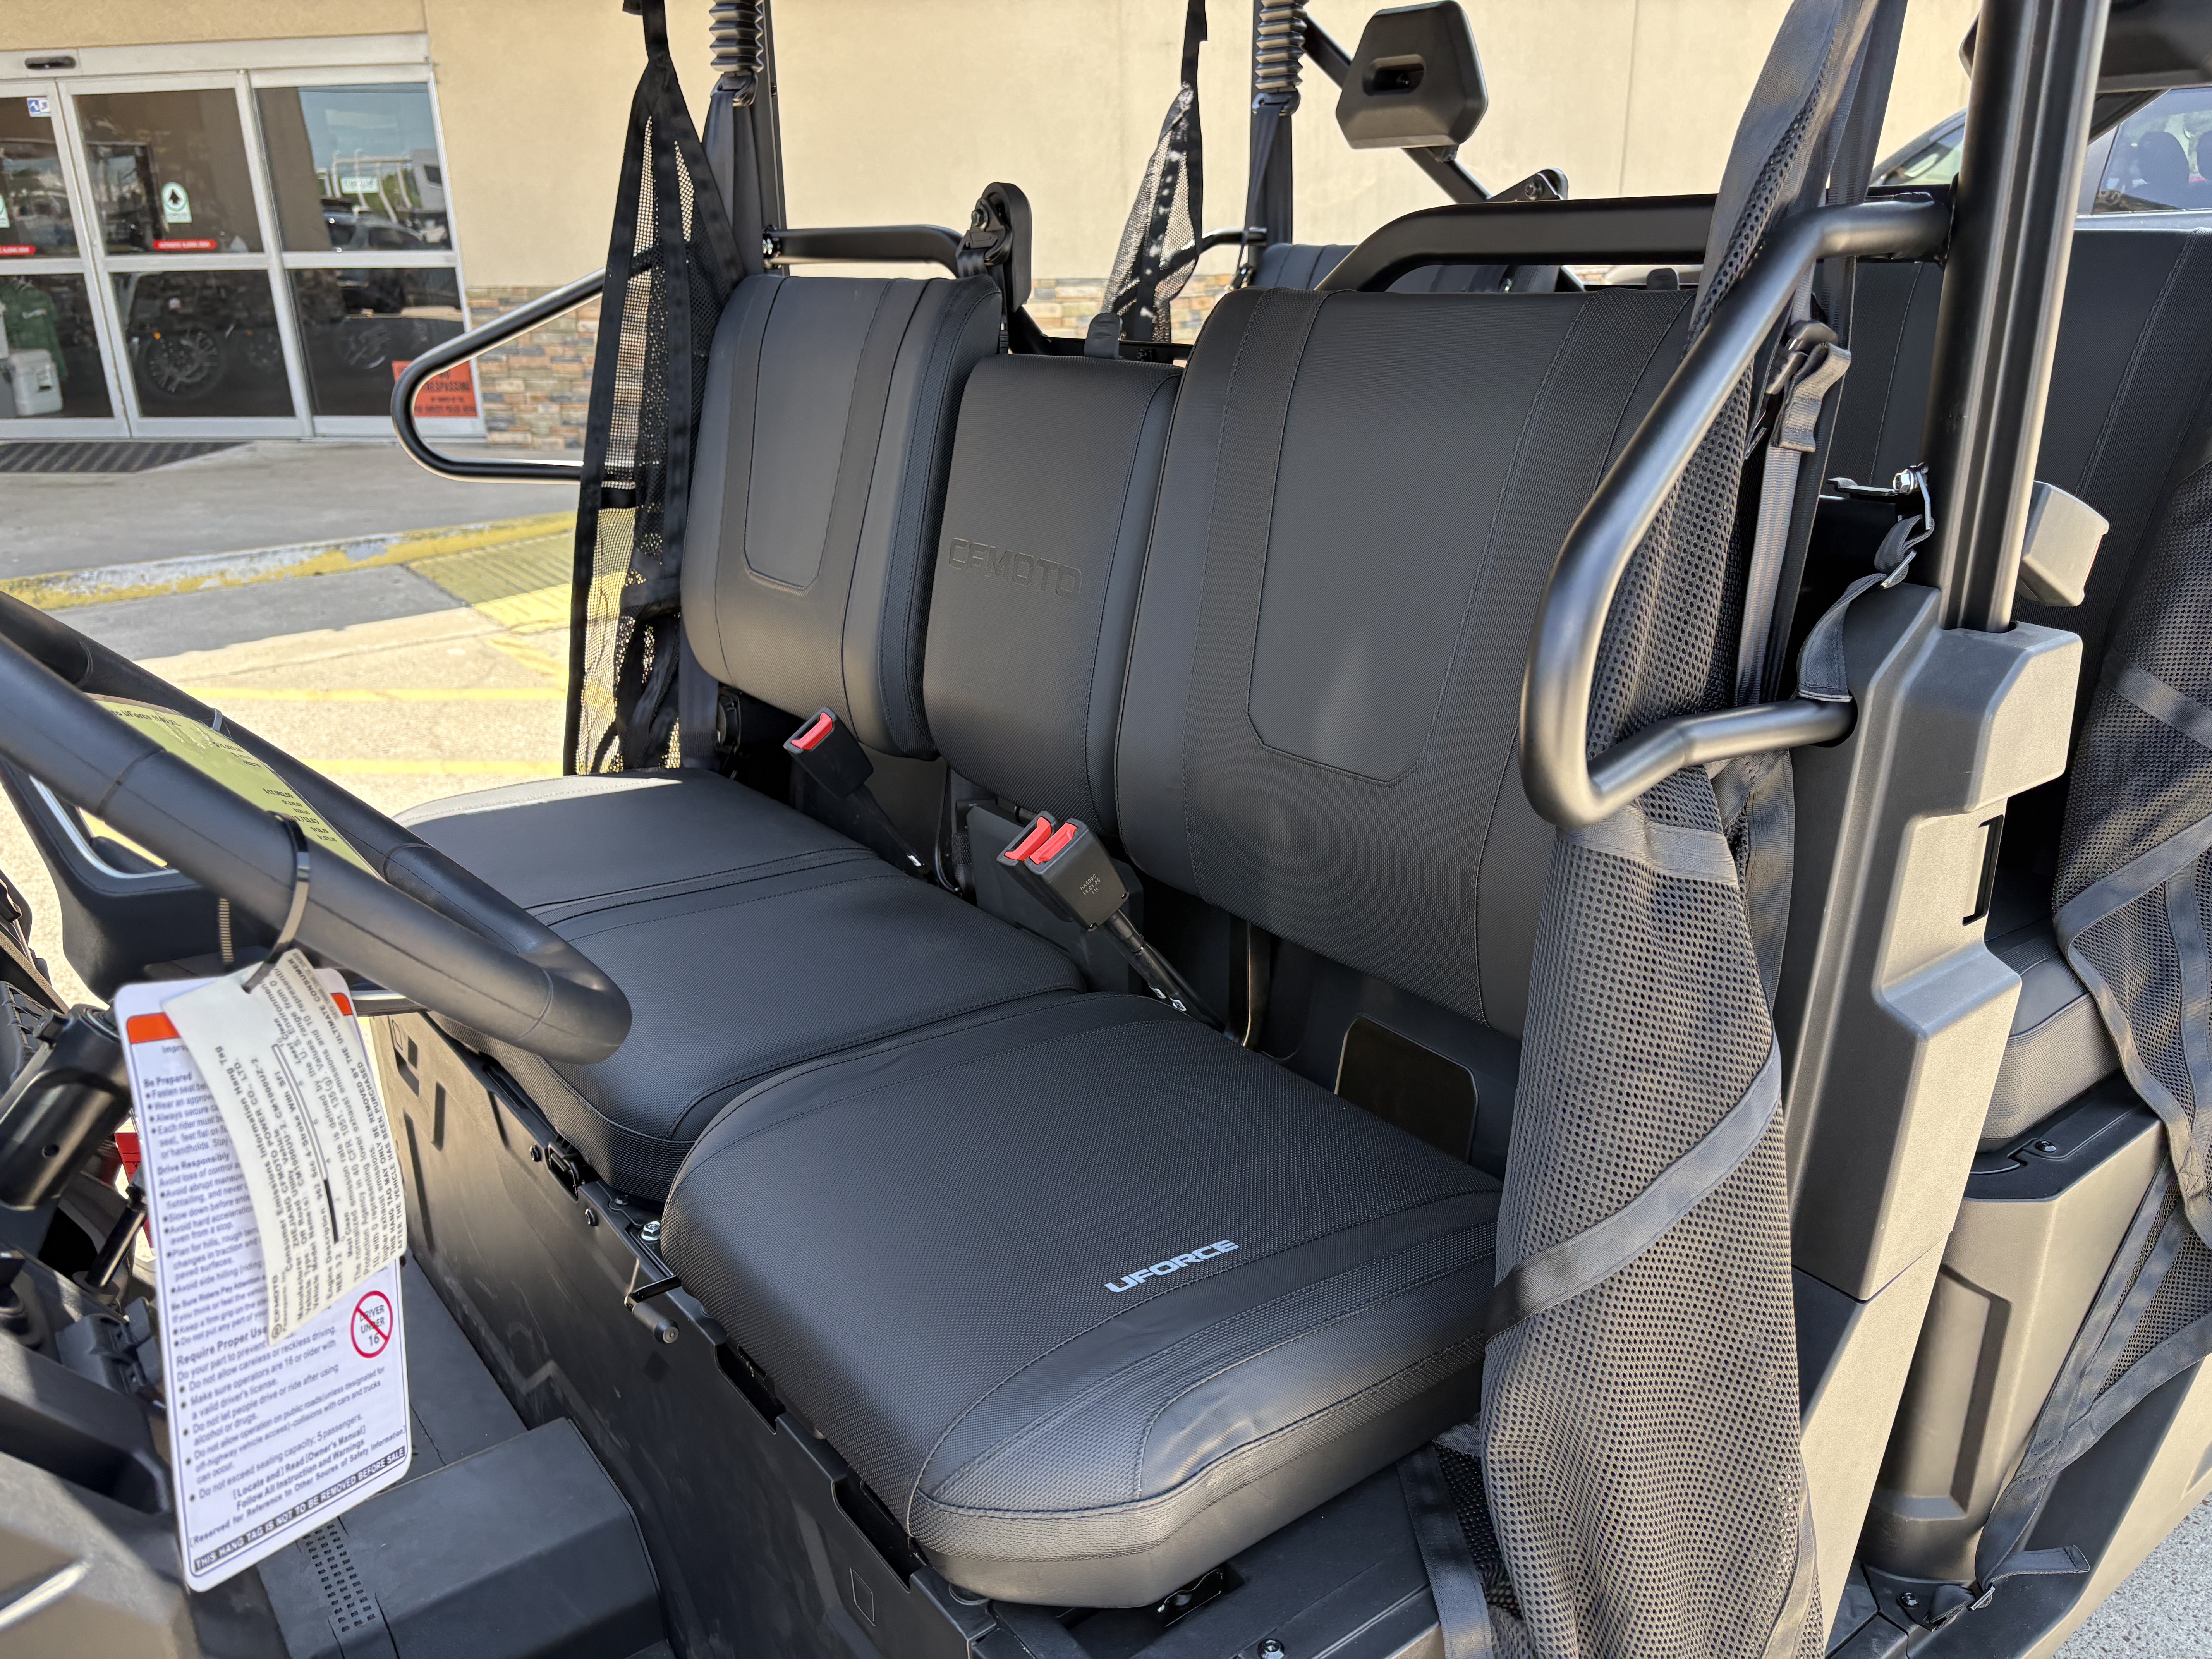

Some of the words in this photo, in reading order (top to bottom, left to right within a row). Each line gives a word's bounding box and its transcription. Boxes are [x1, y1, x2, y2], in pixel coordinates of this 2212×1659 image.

[949, 538, 1082, 599] CFMOTO
[288, 958, 320, 1002] CONSUMER
[277, 989, 292, 1009] from
[274, 1018, 288, 1040] Clean
[291, 1012, 307, 1036] range
[303, 1015, 313, 1026] 10
[319, 1005, 343, 1044] ULTIMATE
[311, 1029, 324, 1046] and
[215, 1046, 227, 1065] Tag
[306, 1040, 323, 1070] Values
[342, 1047, 352, 1064] THE
[227, 1067, 242, 1094] Hang
[306, 1062, 316, 1077] the
[323, 1049, 345, 1093] emissions
[350, 1068, 359, 1079] BY
[314, 1080, 323, 1092] by
[357, 1062, 380, 1113] PURCHASED
[285, 1091, 296, 1112] With
[319, 1095, 335, 1128] defined
[342, 1097, 359, 1132] exhaust
[357, 1082, 374, 1123] REMOVED
[241, 1098, 267, 1158] Information
[255, 1109, 273, 1146] POWER
[333, 1132, 340, 1141] is
[372, 1126, 380, 1138] BE
[377, 1116, 388, 1140] BEEN
[274, 1129, 289, 1164] Vehicle
[337, 1144, 345, 1162] rate
[345, 1139, 356, 1161] CFR
[356, 1137, 366, 1161] lower
[376, 1142, 386, 1164] ONLY
[385, 1142, 393, 1161] HAS
[271, 1150, 288, 1193] CFMOTO
[351, 1164, 359, 1175] 40
[356, 1178, 362, 1189] in
[390, 1163, 400, 1200] VEHICLE
[265, 1161, 283, 1216] Emissions
[343, 1166, 356, 1206] emission
[363, 1163, 377, 1220] representing
[284, 1197, 299, 1248] ZHEJIANG
[294, 1200, 304, 1226] Road
[359, 1192, 369, 1225] Agency
[378, 1195, 387, 1230] exhaust
[280, 1220, 293, 1272] Consumer
[350, 1210, 361, 1260] normalized
[382, 1234, 390, 1262] higher
[1104, 1239, 1240, 1293] UFORCE
[176, 1346, 215, 1367] Require
[217, 1333, 248, 1351] Proper
[368, 1332, 380, 1346] 16
[191, 1391, 213, 1405] Make
[236, 1492, 263, 1511] Follow
[332, 1439, 364, 1460] Warnings
[285, 1456, 304, 1472] Read
[197, 1553, 216, 1571] THIS
[219, 1537, 244, 1556] HANG
[247, 1527, 263, 1541] TAG
[265, 1521, 274, 1532] IS
[276, 1511, 292, 1525] NOT
[295, 1504, 306, 1515] TO
[308, 1497, 318, 1508] BE
[321, 1476, 356, 1500] REMOVED
[358, 1459, 385, 1480] BEFORE
[387, 1449, 403, 1464] SALE
